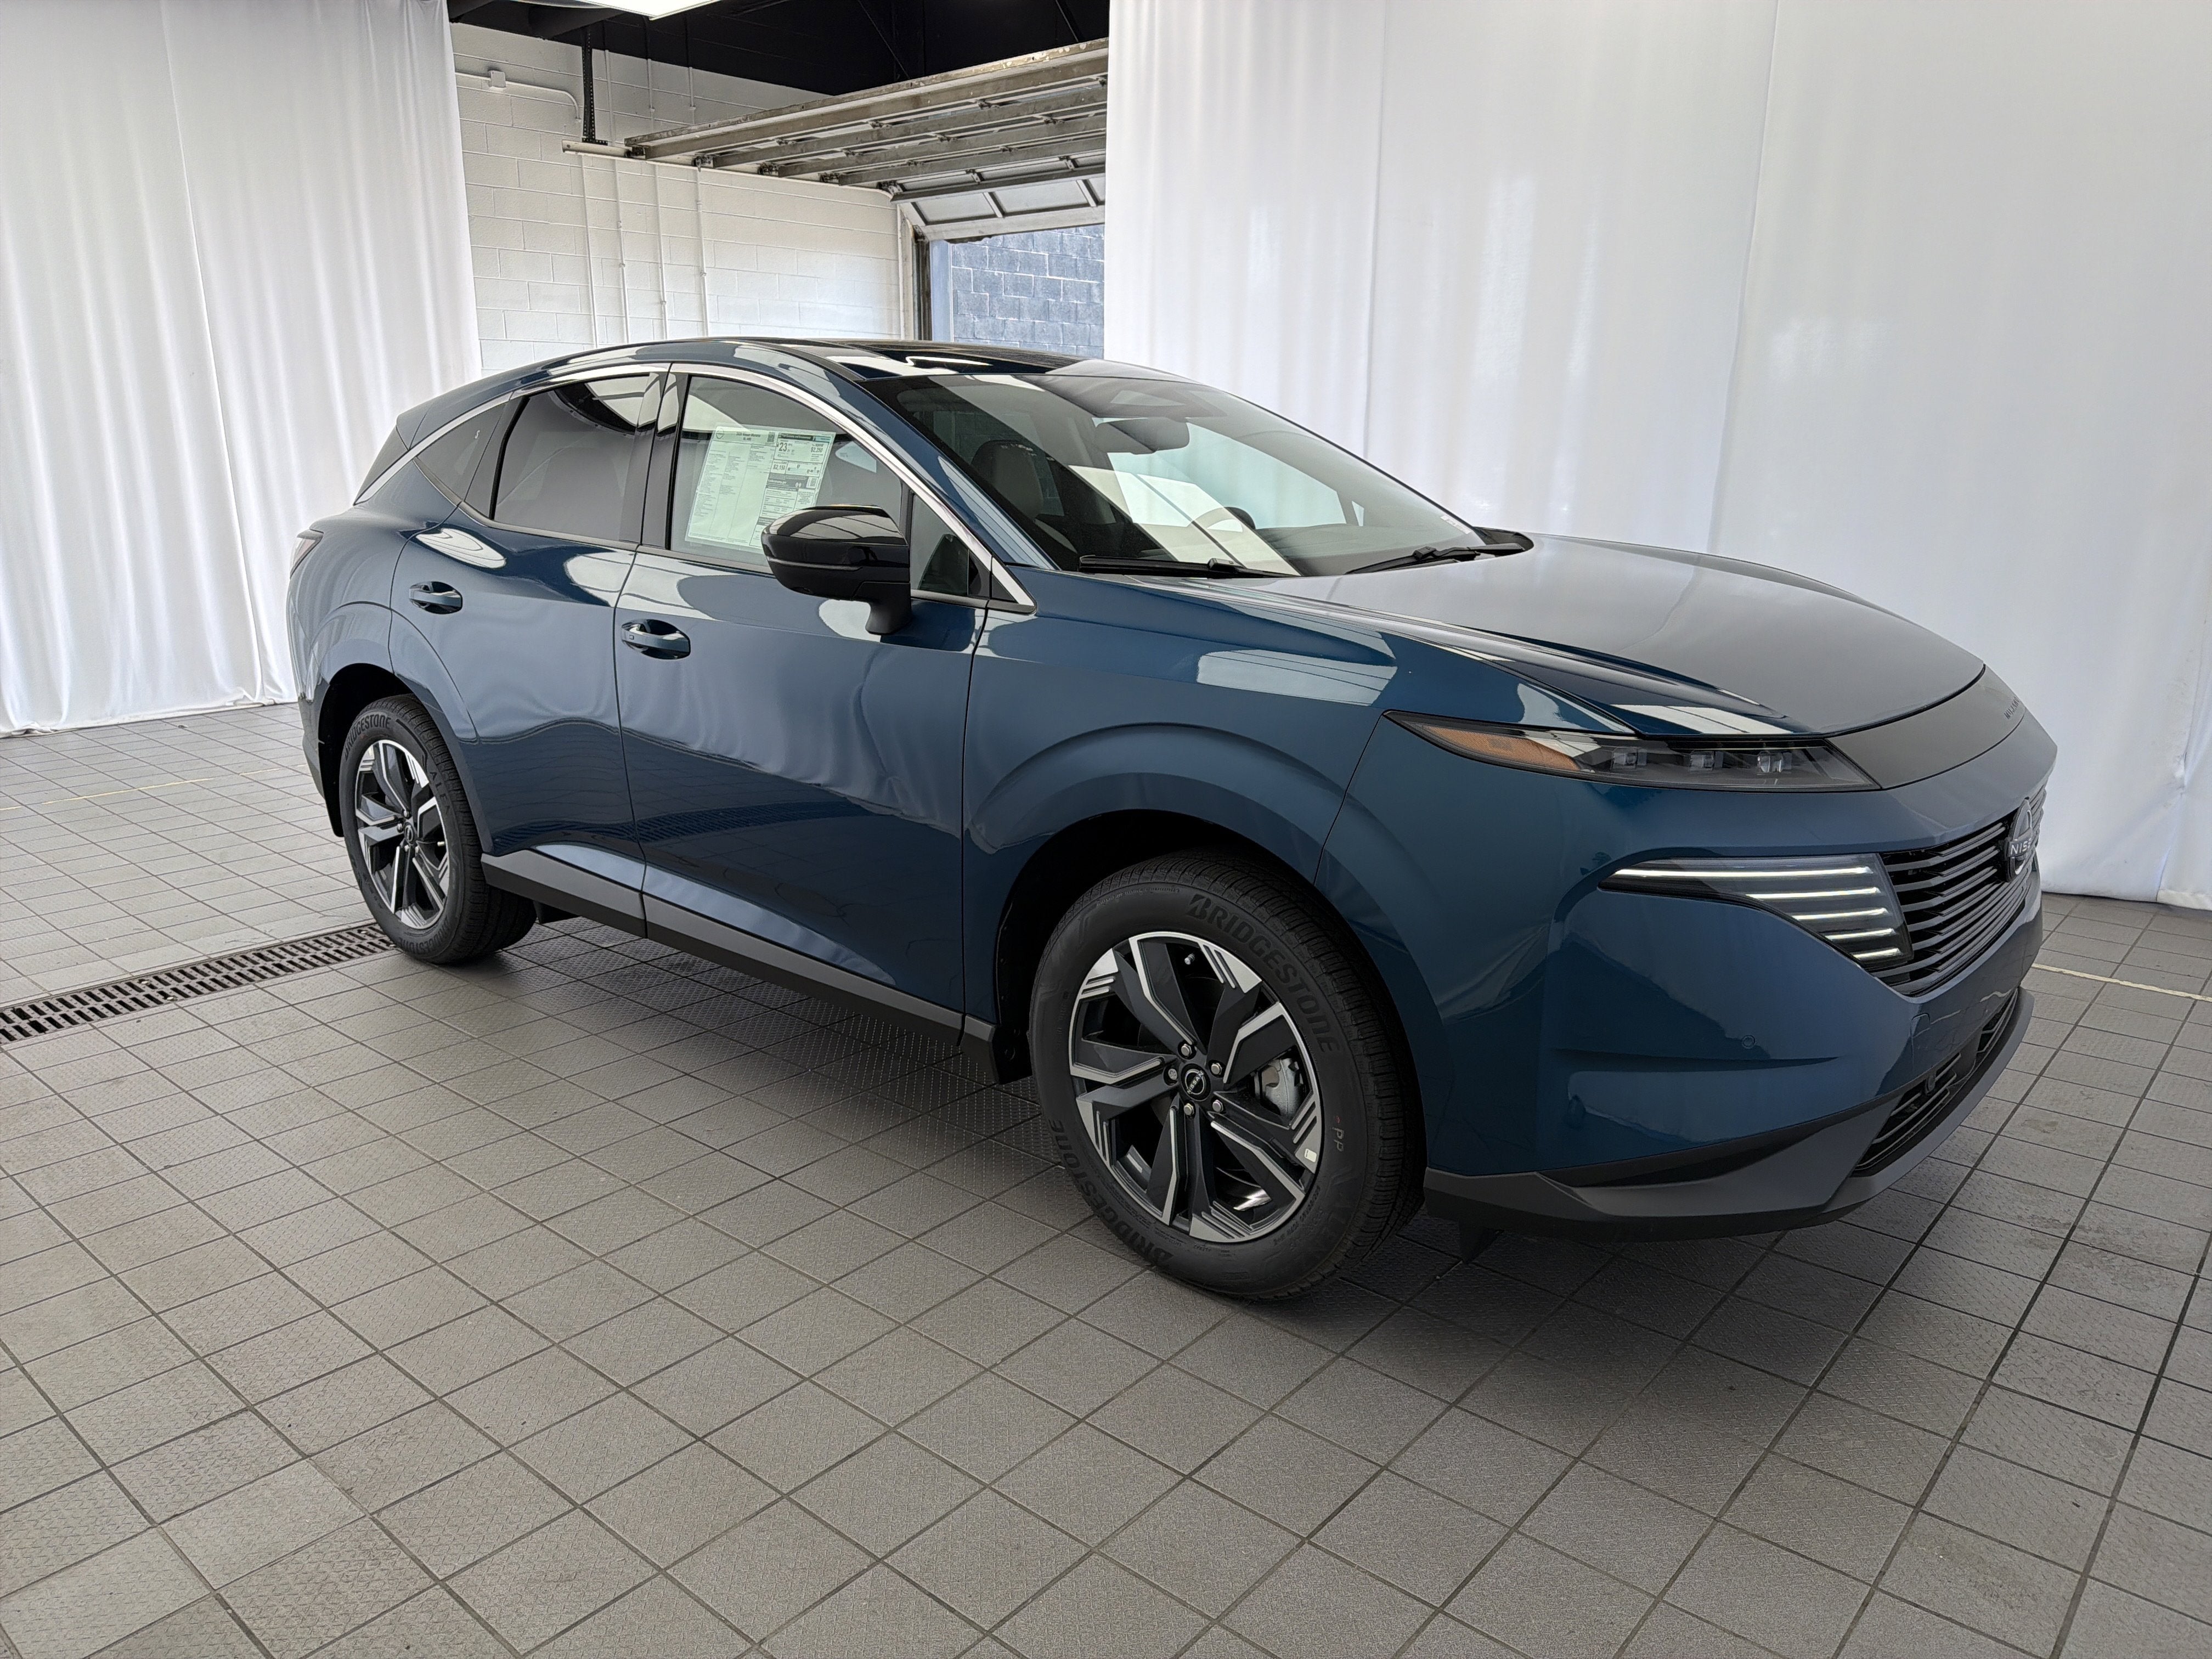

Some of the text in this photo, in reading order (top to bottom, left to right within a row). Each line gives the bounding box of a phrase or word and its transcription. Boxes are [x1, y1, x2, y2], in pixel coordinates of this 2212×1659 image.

[779, 442, 788, 452] 23
[345, 713, 392, 761] BRIDGESTONE
[1186, 893, 1343, 1053] BRIDGESTONE
[1187, 1070, 1204, 1094] NISSAN
